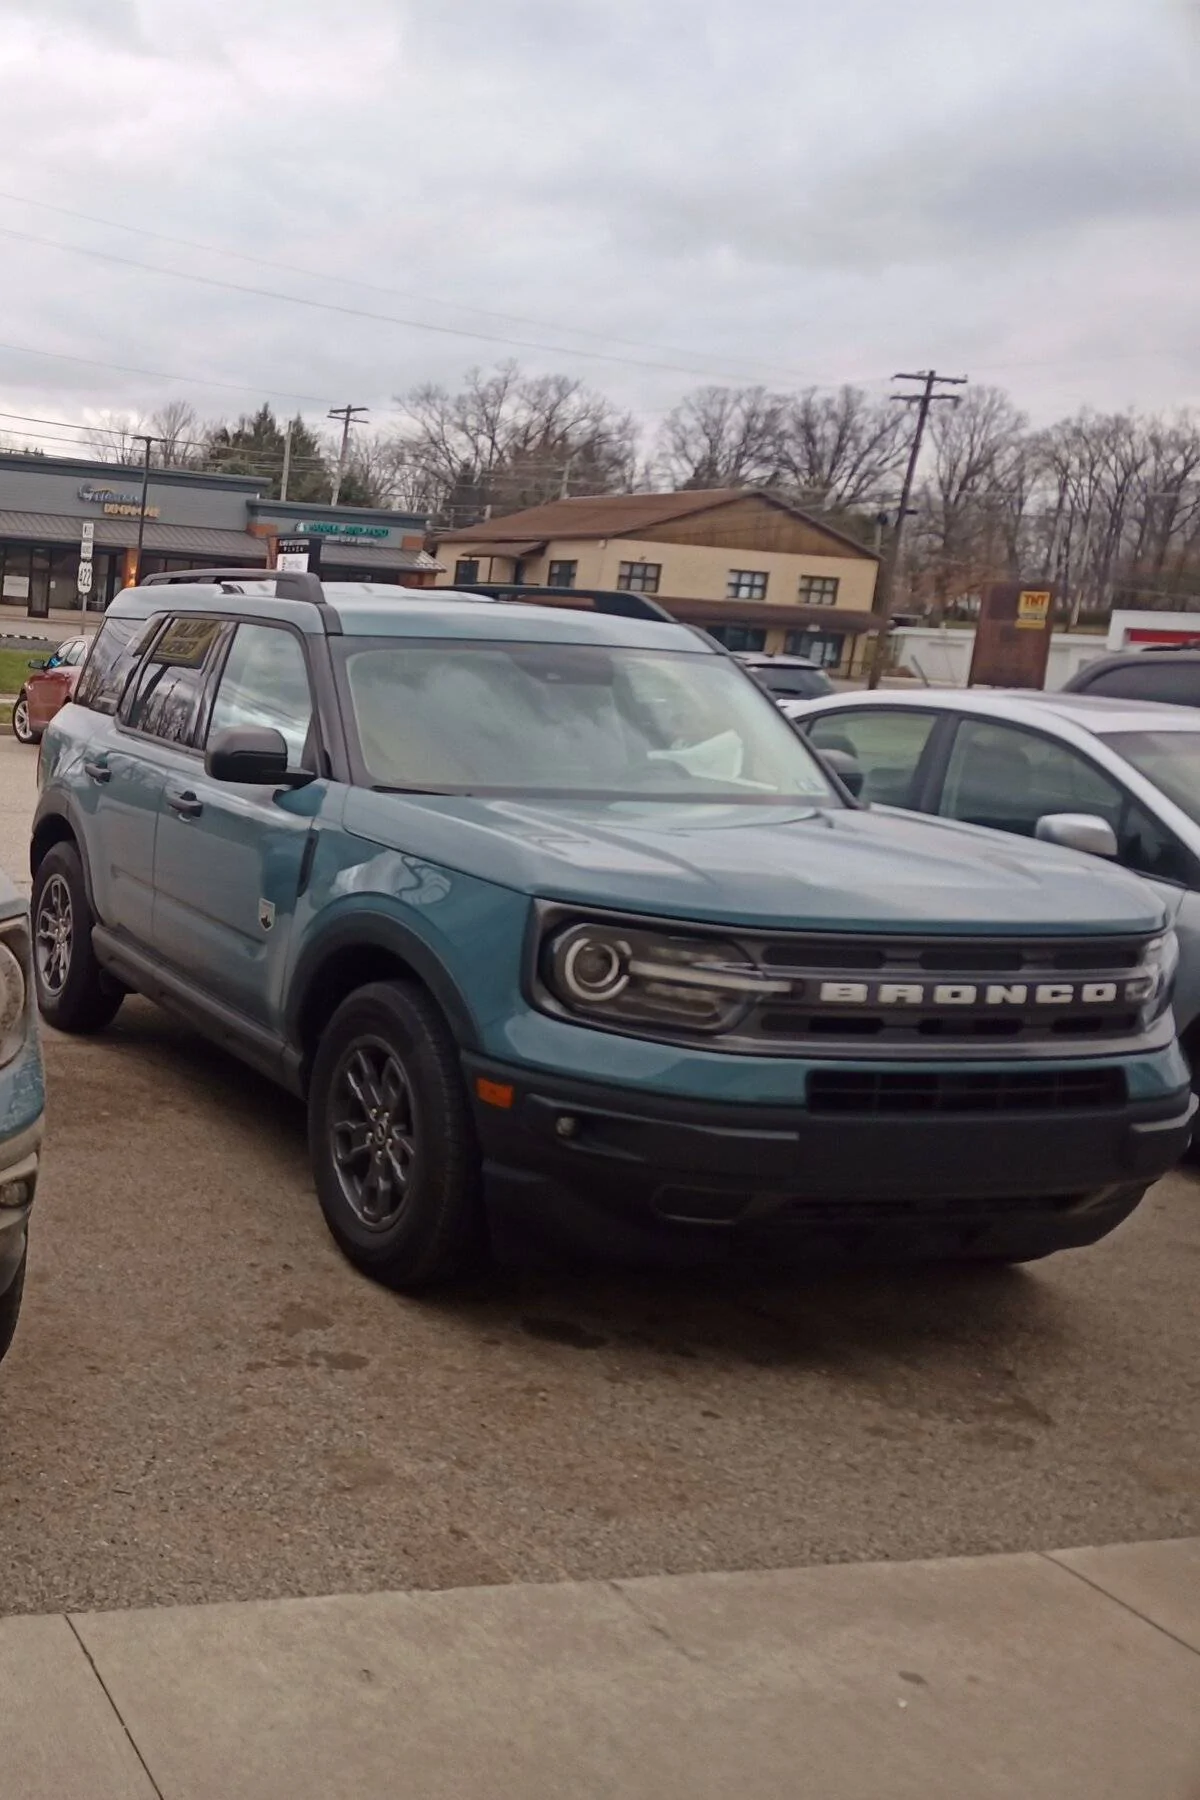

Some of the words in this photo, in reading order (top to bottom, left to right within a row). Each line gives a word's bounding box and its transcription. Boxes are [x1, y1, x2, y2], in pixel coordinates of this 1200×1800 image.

[80, 567, 91, 587] 422
[1024, 594, 1048, 606] TNT
[820, 982, 1117, 1004] BRONCO
